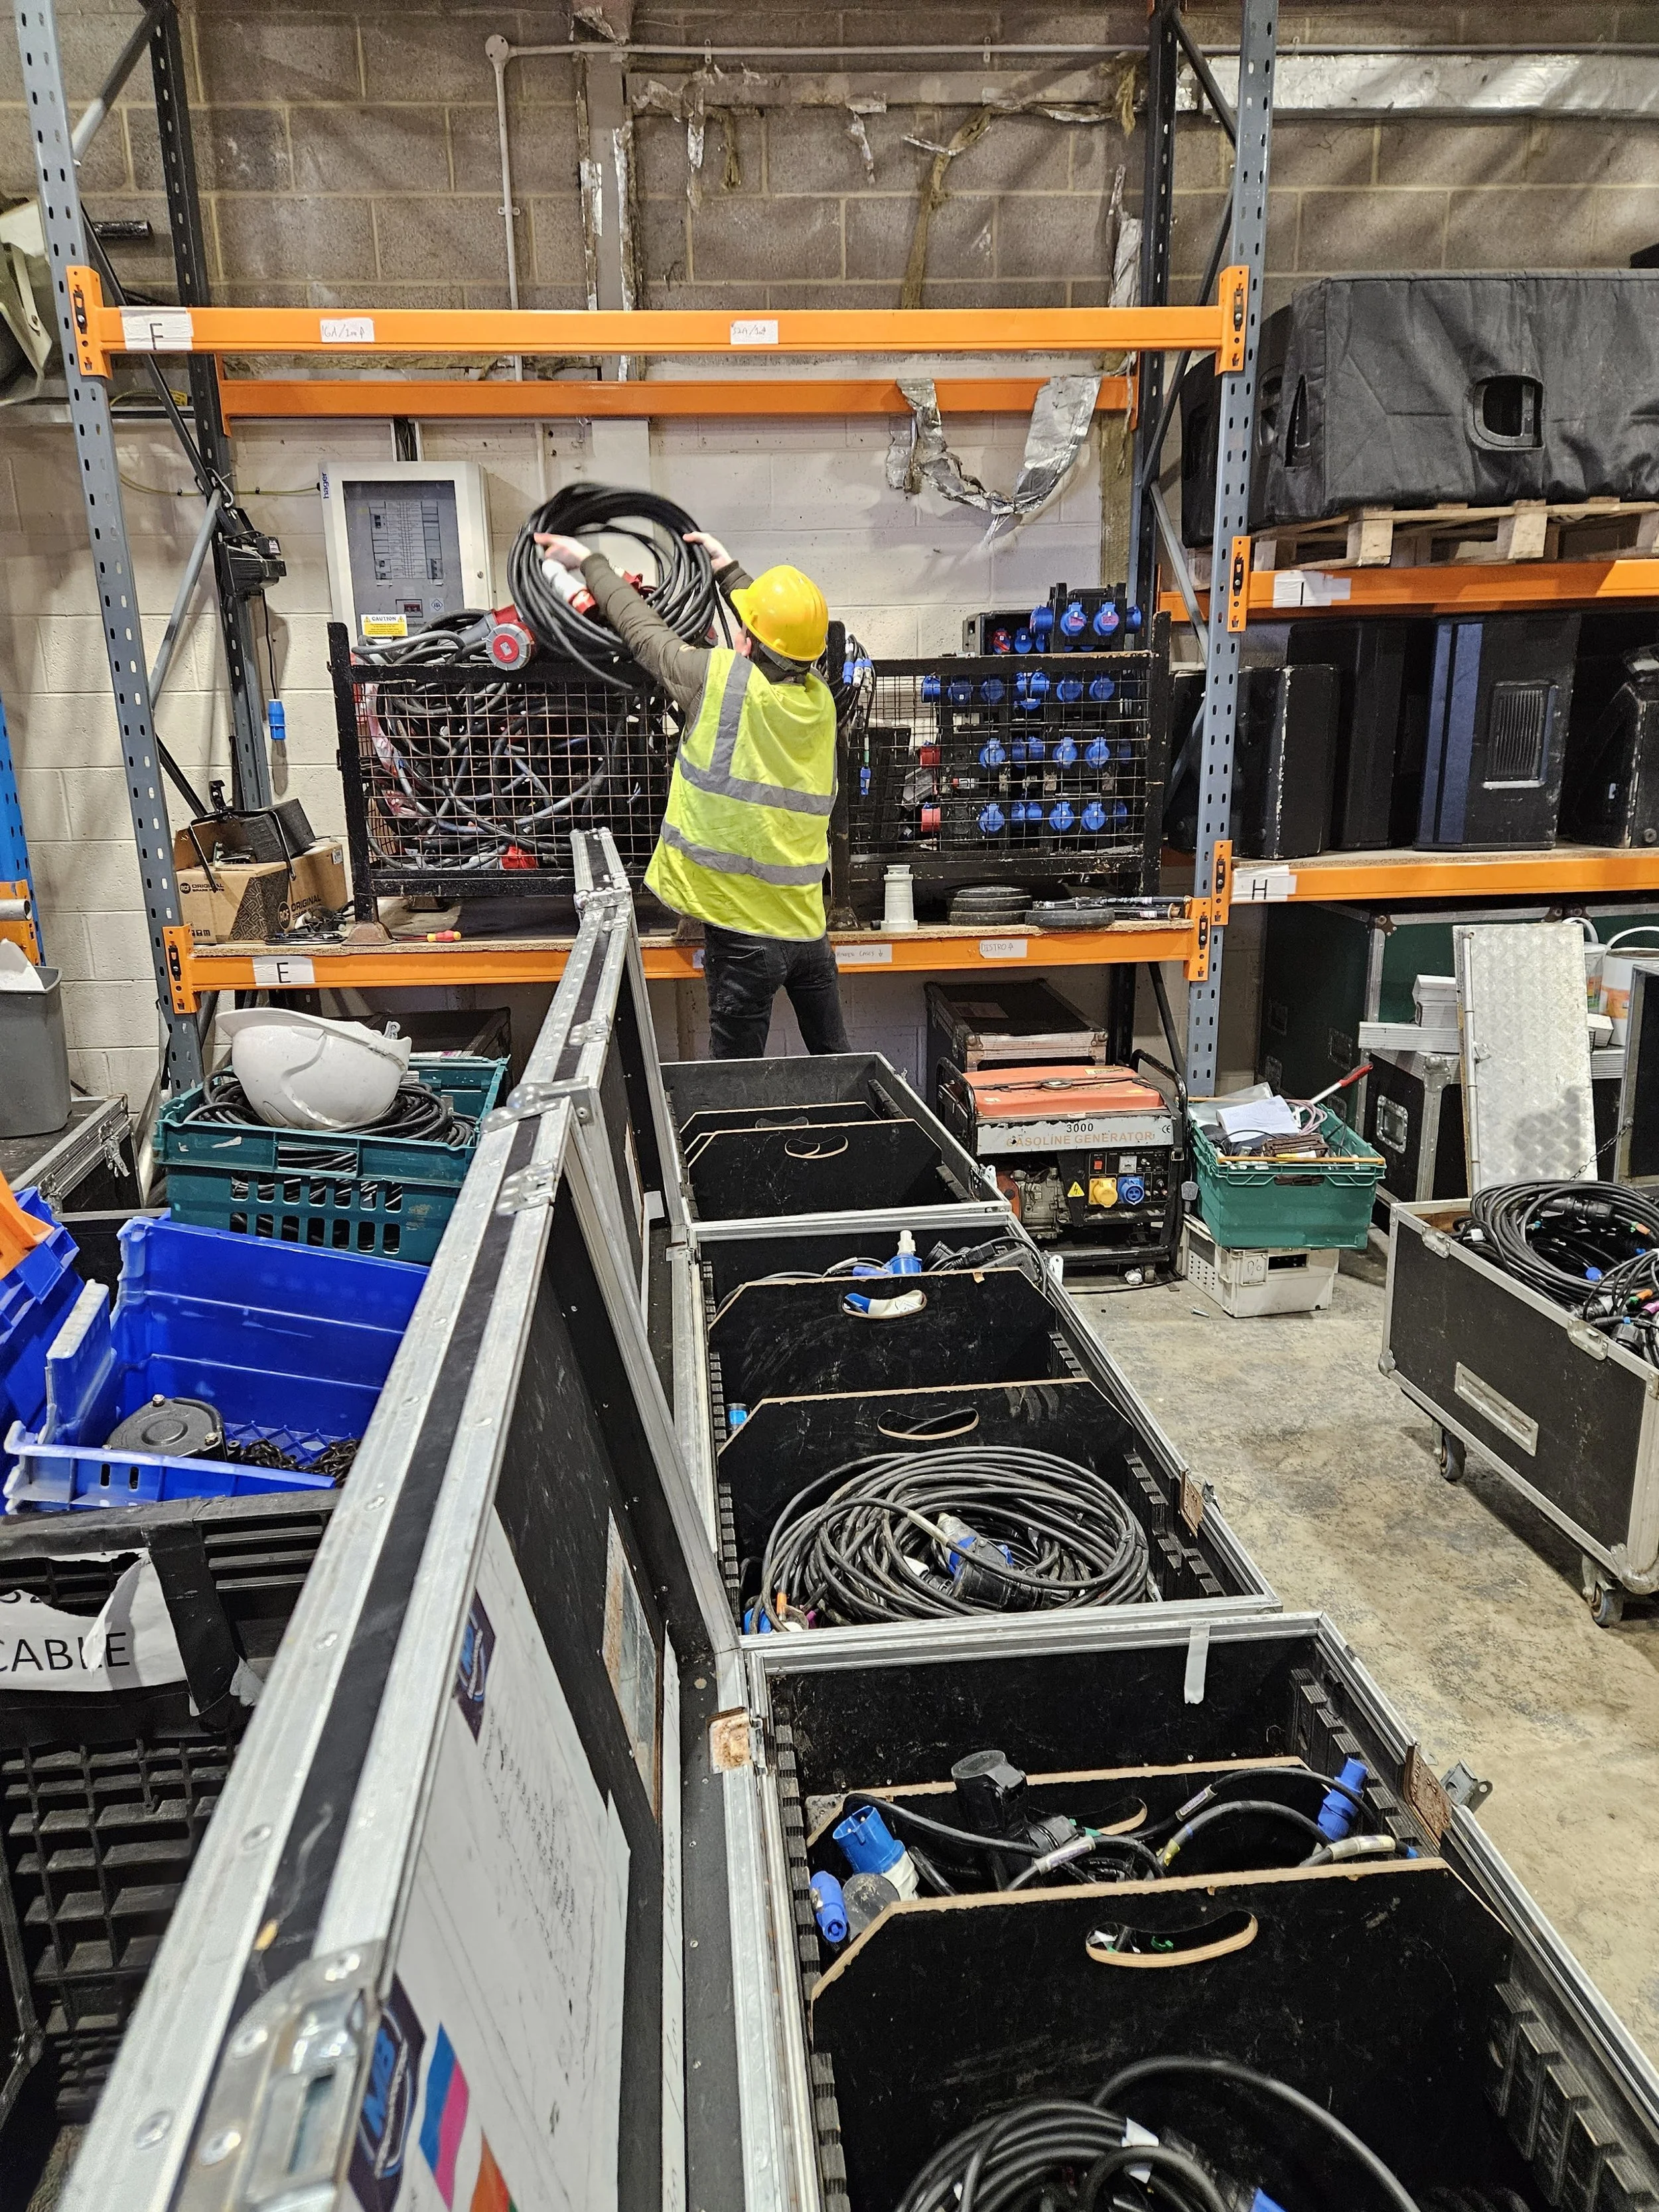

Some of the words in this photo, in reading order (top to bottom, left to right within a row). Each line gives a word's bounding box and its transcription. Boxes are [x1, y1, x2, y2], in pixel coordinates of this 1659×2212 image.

[150, 323, 163, 350] F
[1252, 879, 1268, 900] H
[291, 895, 321, 912] ORIGINAL
[981, 943, 1007, 952] DISTRO
[276, 962, 291, 984] E
[1066, 1123, 1094, 1133] 3000
[1007, 1136, 1071, 1147] GASOLINE
[1075, 1131, 1153, 1143] GENERATOR
[0, 1631, 131, 1672] ABLE
